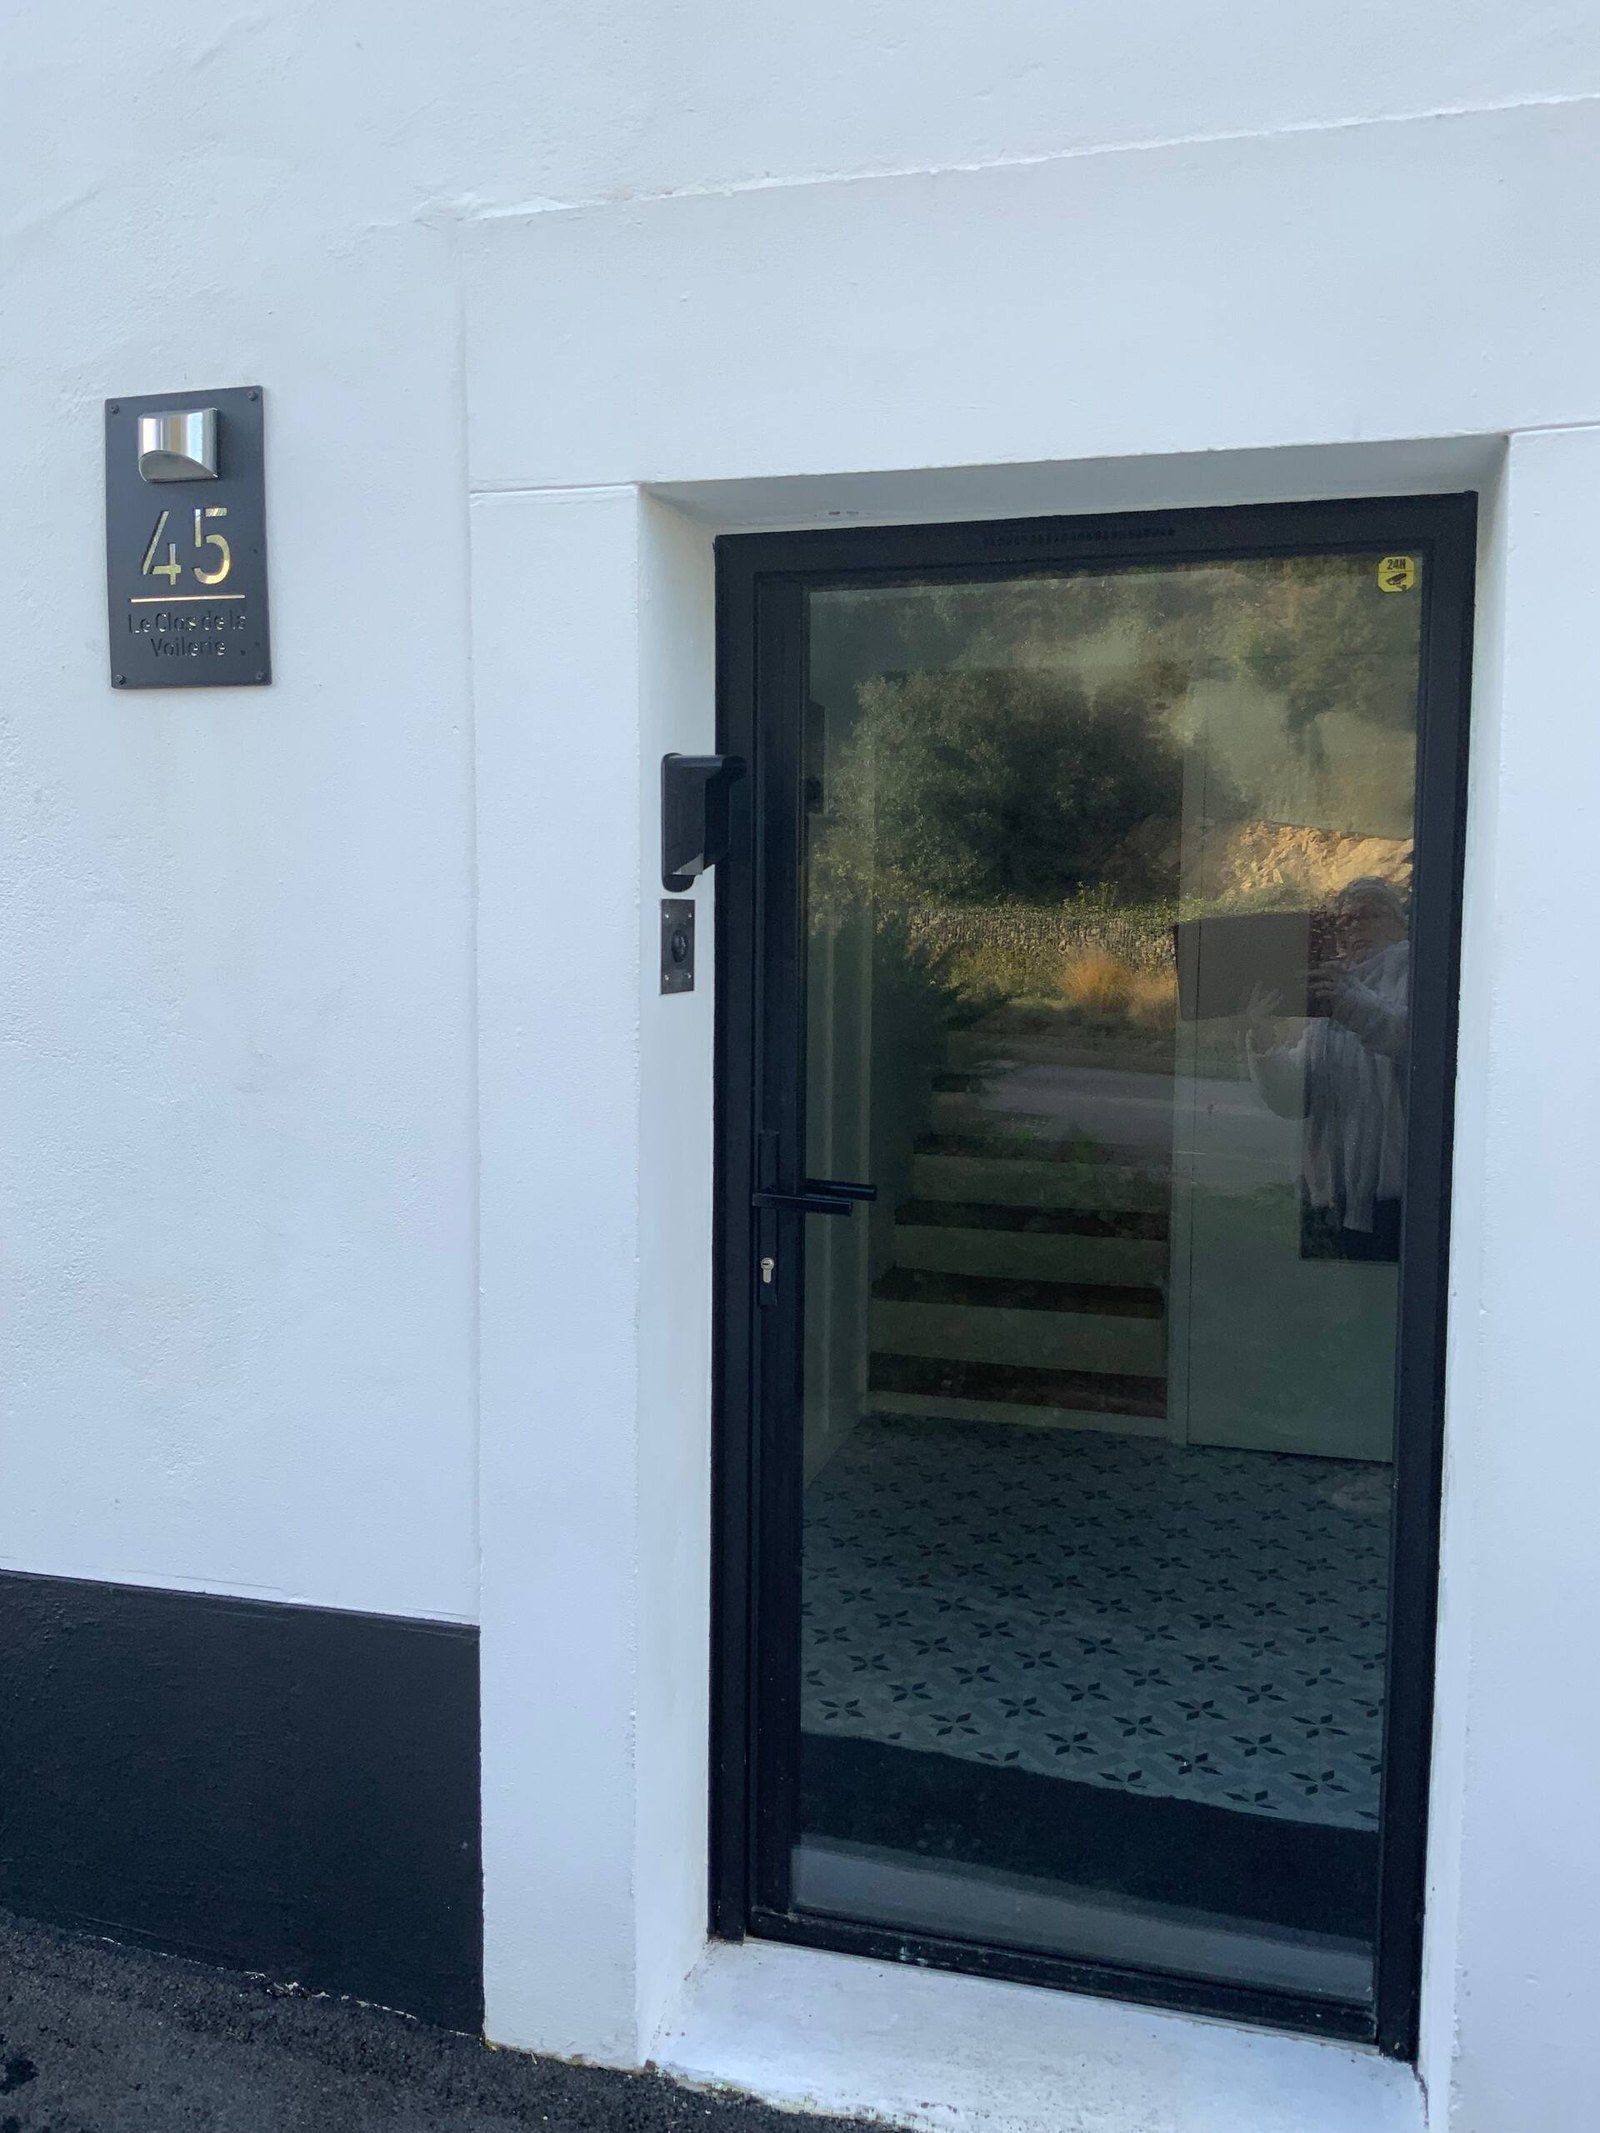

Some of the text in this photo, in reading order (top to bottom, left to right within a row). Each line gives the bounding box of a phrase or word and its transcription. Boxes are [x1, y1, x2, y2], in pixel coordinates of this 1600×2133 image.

[141, 506, 231, 586] 45
[1386, 558, 1406, 570] 24H
[128, 608, 247, 634] Le Clos de la
[150, 635, 227, 657] Voilerie
